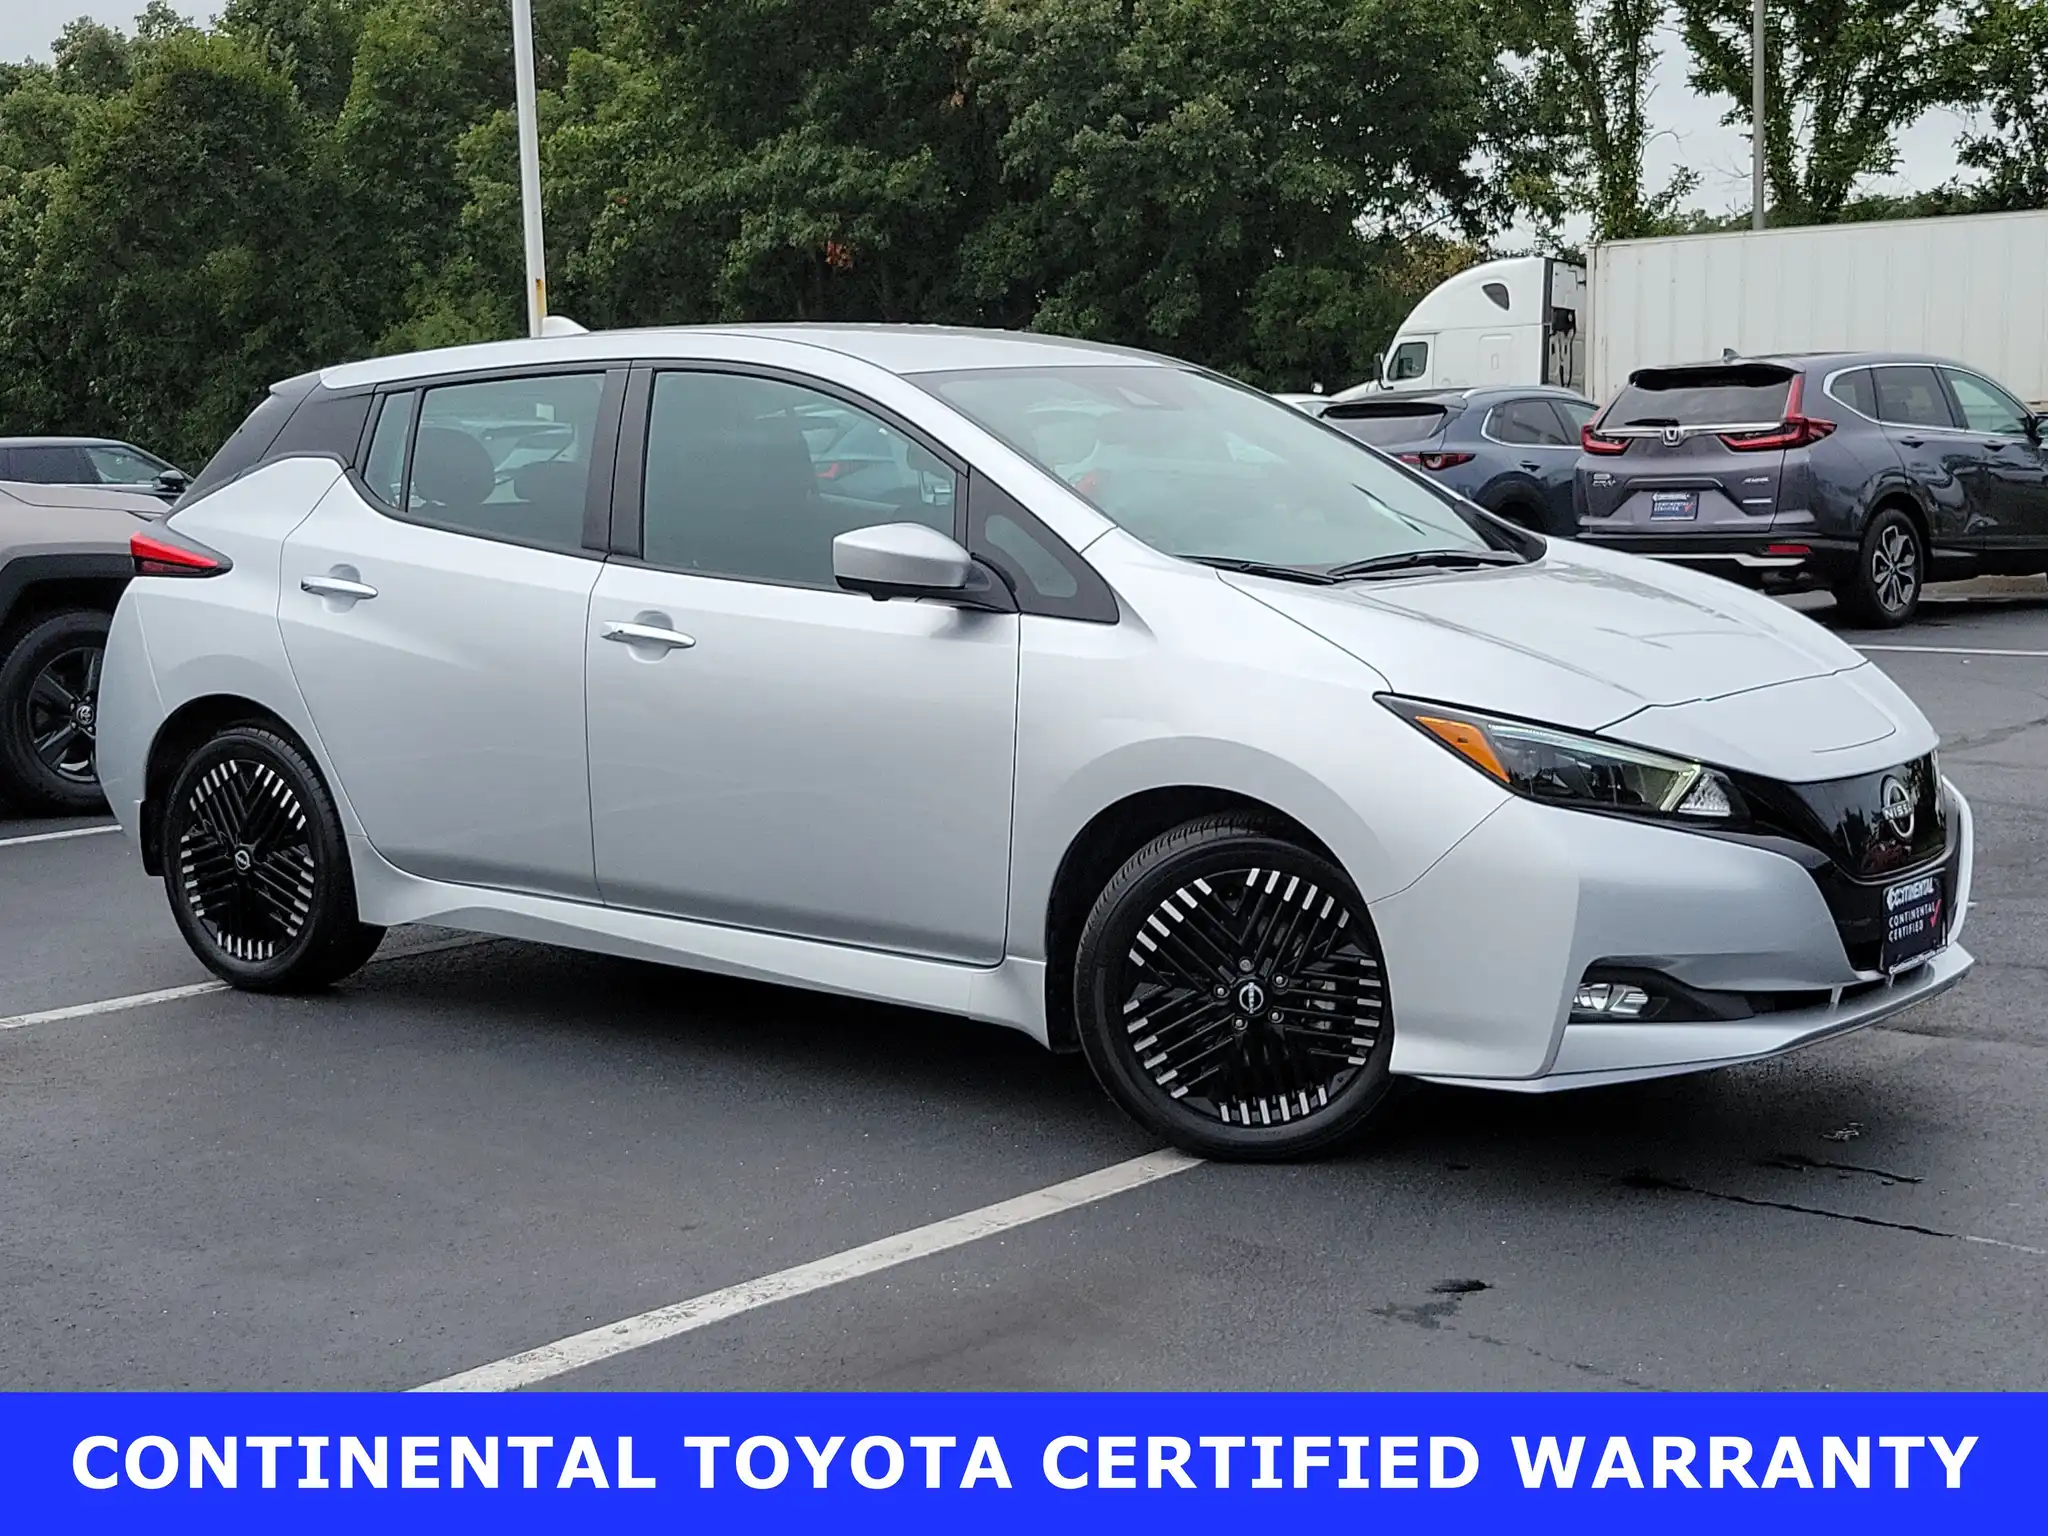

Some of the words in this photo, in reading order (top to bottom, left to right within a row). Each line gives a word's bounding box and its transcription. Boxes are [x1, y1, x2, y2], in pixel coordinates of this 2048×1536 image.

[1884, 803, 1912, 820] NISS
[1888, 901, 1936, 929] CONTINENTAL
[1888, 919, 1924, 943] CERTIFIED
